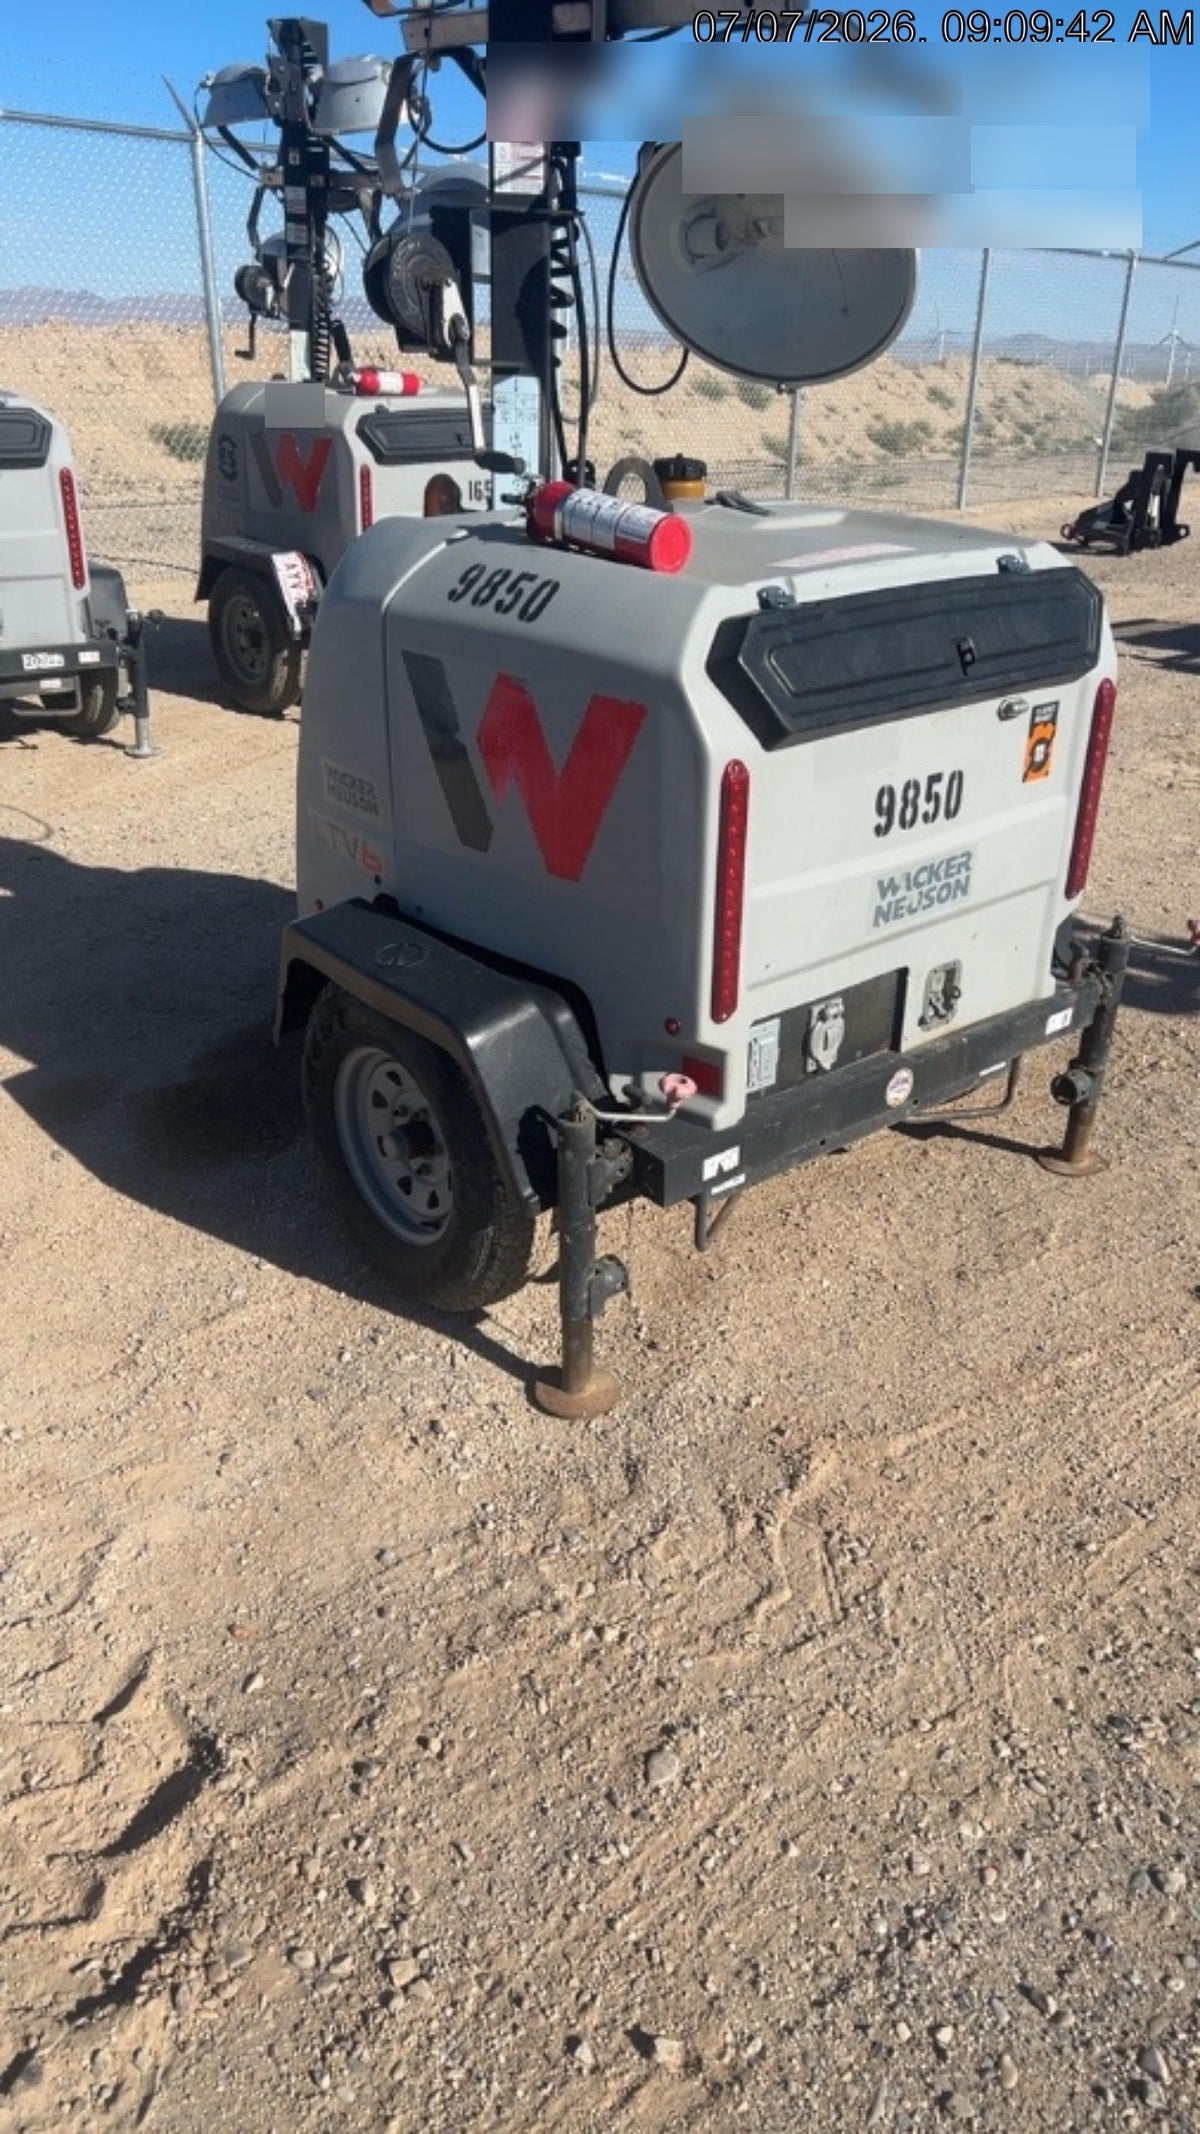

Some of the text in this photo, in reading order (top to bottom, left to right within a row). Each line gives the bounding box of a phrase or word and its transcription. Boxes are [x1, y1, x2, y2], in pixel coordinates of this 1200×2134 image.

[447, 563, 561, 623] 9850
[873, 769, 964, 838] 9850
[872, 874, 971, 928] NEUSON
